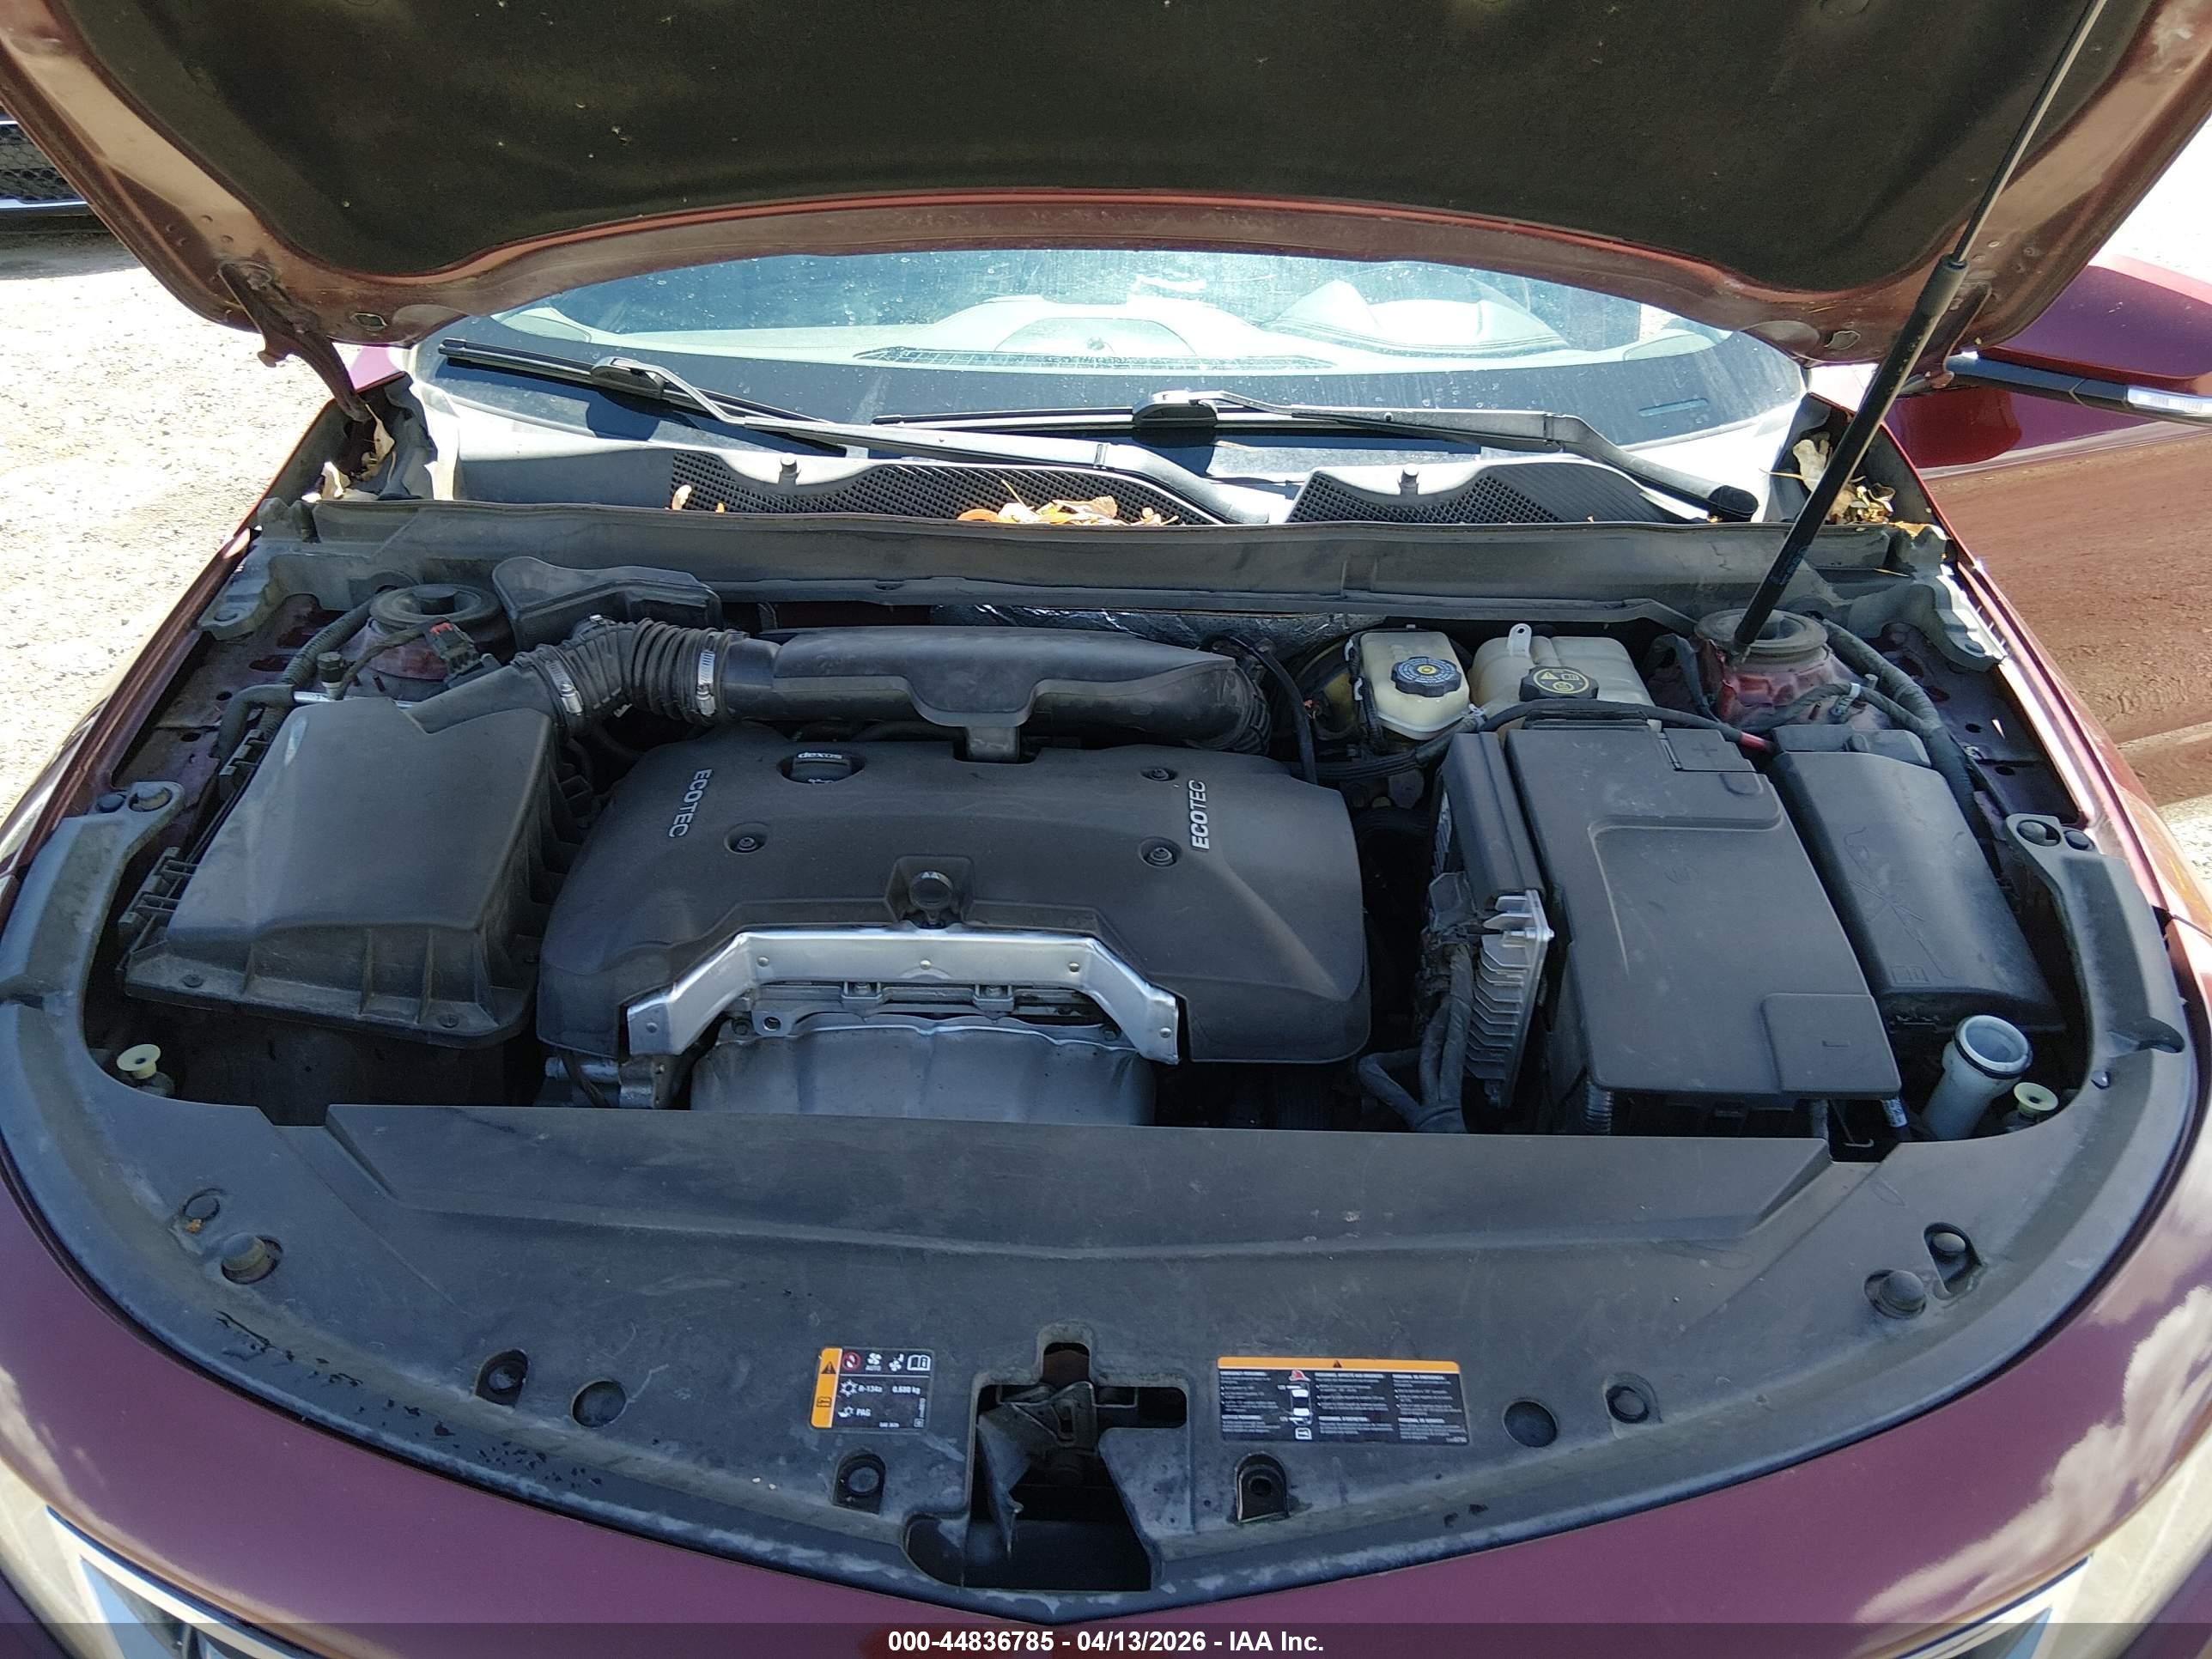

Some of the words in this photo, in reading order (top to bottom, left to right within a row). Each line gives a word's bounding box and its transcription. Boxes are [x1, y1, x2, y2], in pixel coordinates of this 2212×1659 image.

[669, 769, 713, 838] ECOTEC
[1188, 780, 1210, 849] ECOTEC
[855, 1407, 872, 1417] PAG
